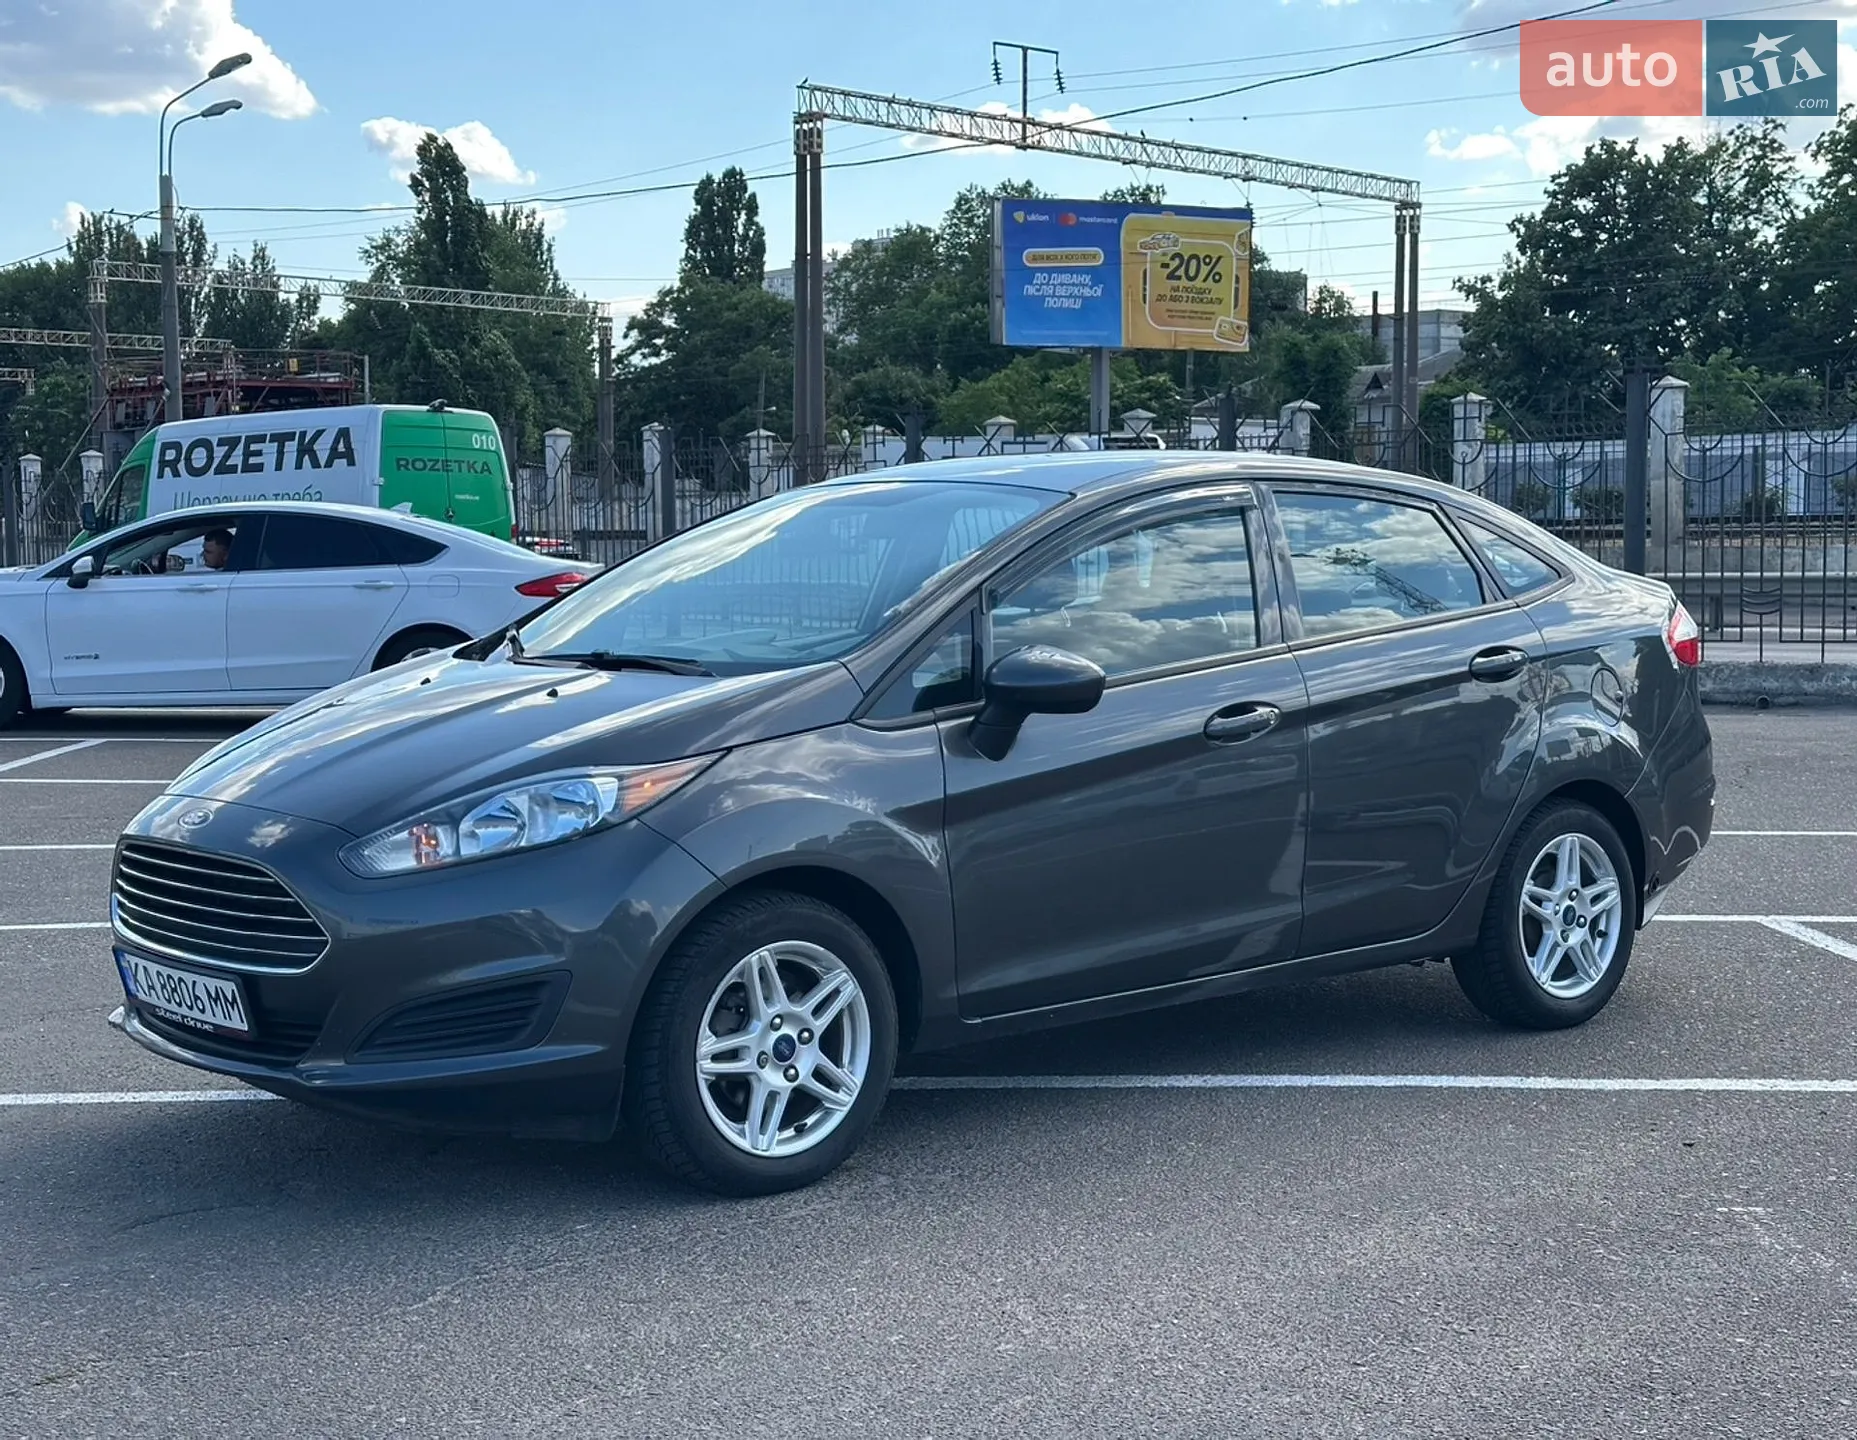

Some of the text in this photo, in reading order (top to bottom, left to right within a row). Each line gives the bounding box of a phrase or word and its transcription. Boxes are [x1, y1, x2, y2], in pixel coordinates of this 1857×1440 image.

[1161, 252, 1223, 283] -20%
[1033, 273, 1092, 285] ДО ДИВАНУ,
[1023, 283, 1104, 297] ПІСЛЯ ВЕРХНЬОЇ
[1170, 285, 1180, 293] НА
[1044, 297, 1082, 309] ПОЛИЦІ
[1155, 294, 1168, 303] ДО
[1168, 294, 1184, 303] АБО
[1191, 296, 1225, 305] ВОКЗАЛУ
[472, 433, 496, 450] 010
[156, 427, 356, 480] ROZETKA
[395, 457, 493, 475] ROZETKA
[127, 959, 244, 1024] KA 8806 MM
